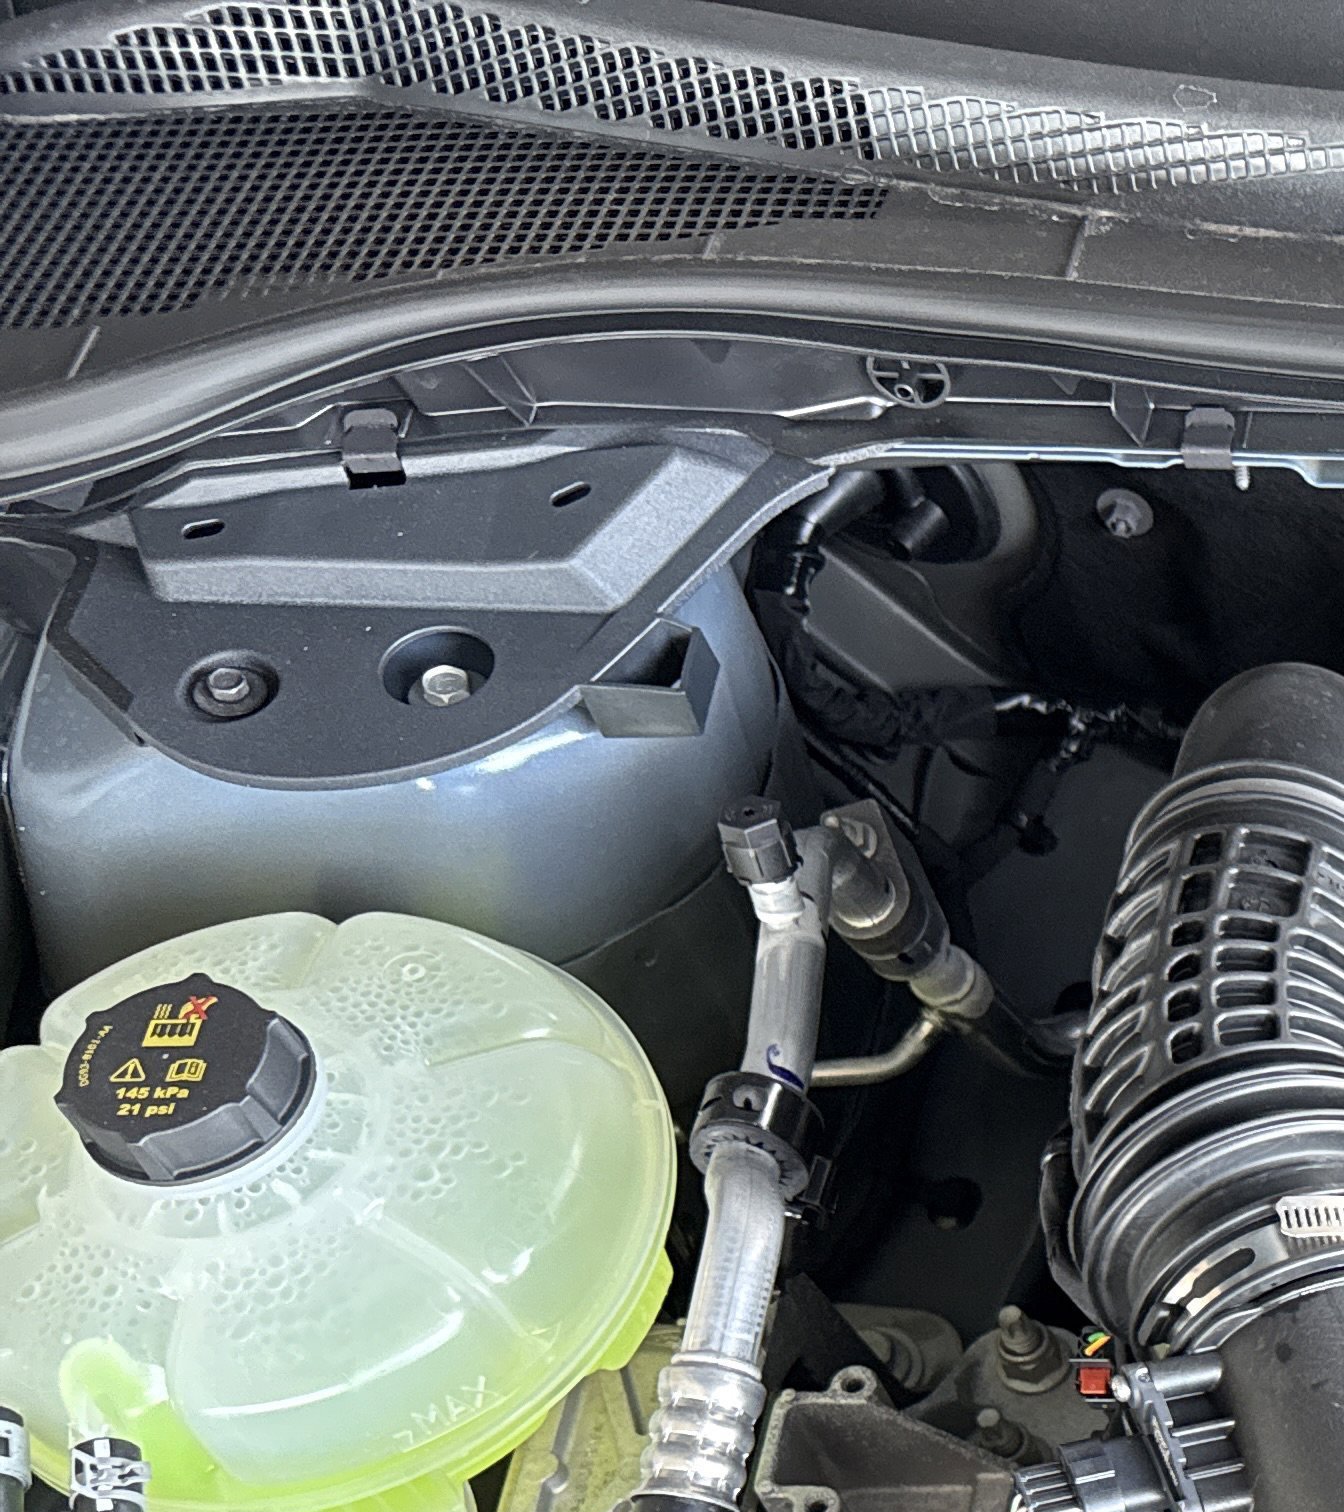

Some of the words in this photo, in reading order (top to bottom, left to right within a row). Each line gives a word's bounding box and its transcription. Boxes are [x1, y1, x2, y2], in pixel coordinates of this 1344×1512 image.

[115, 1086, 150, 1100] 145
[153, 1086, 190, 1099] kPa
[116, 1103, 141, 1116] 21
[144, 1103, 176, 1118] psi
[411, 1375, 499, 1435] MAX
